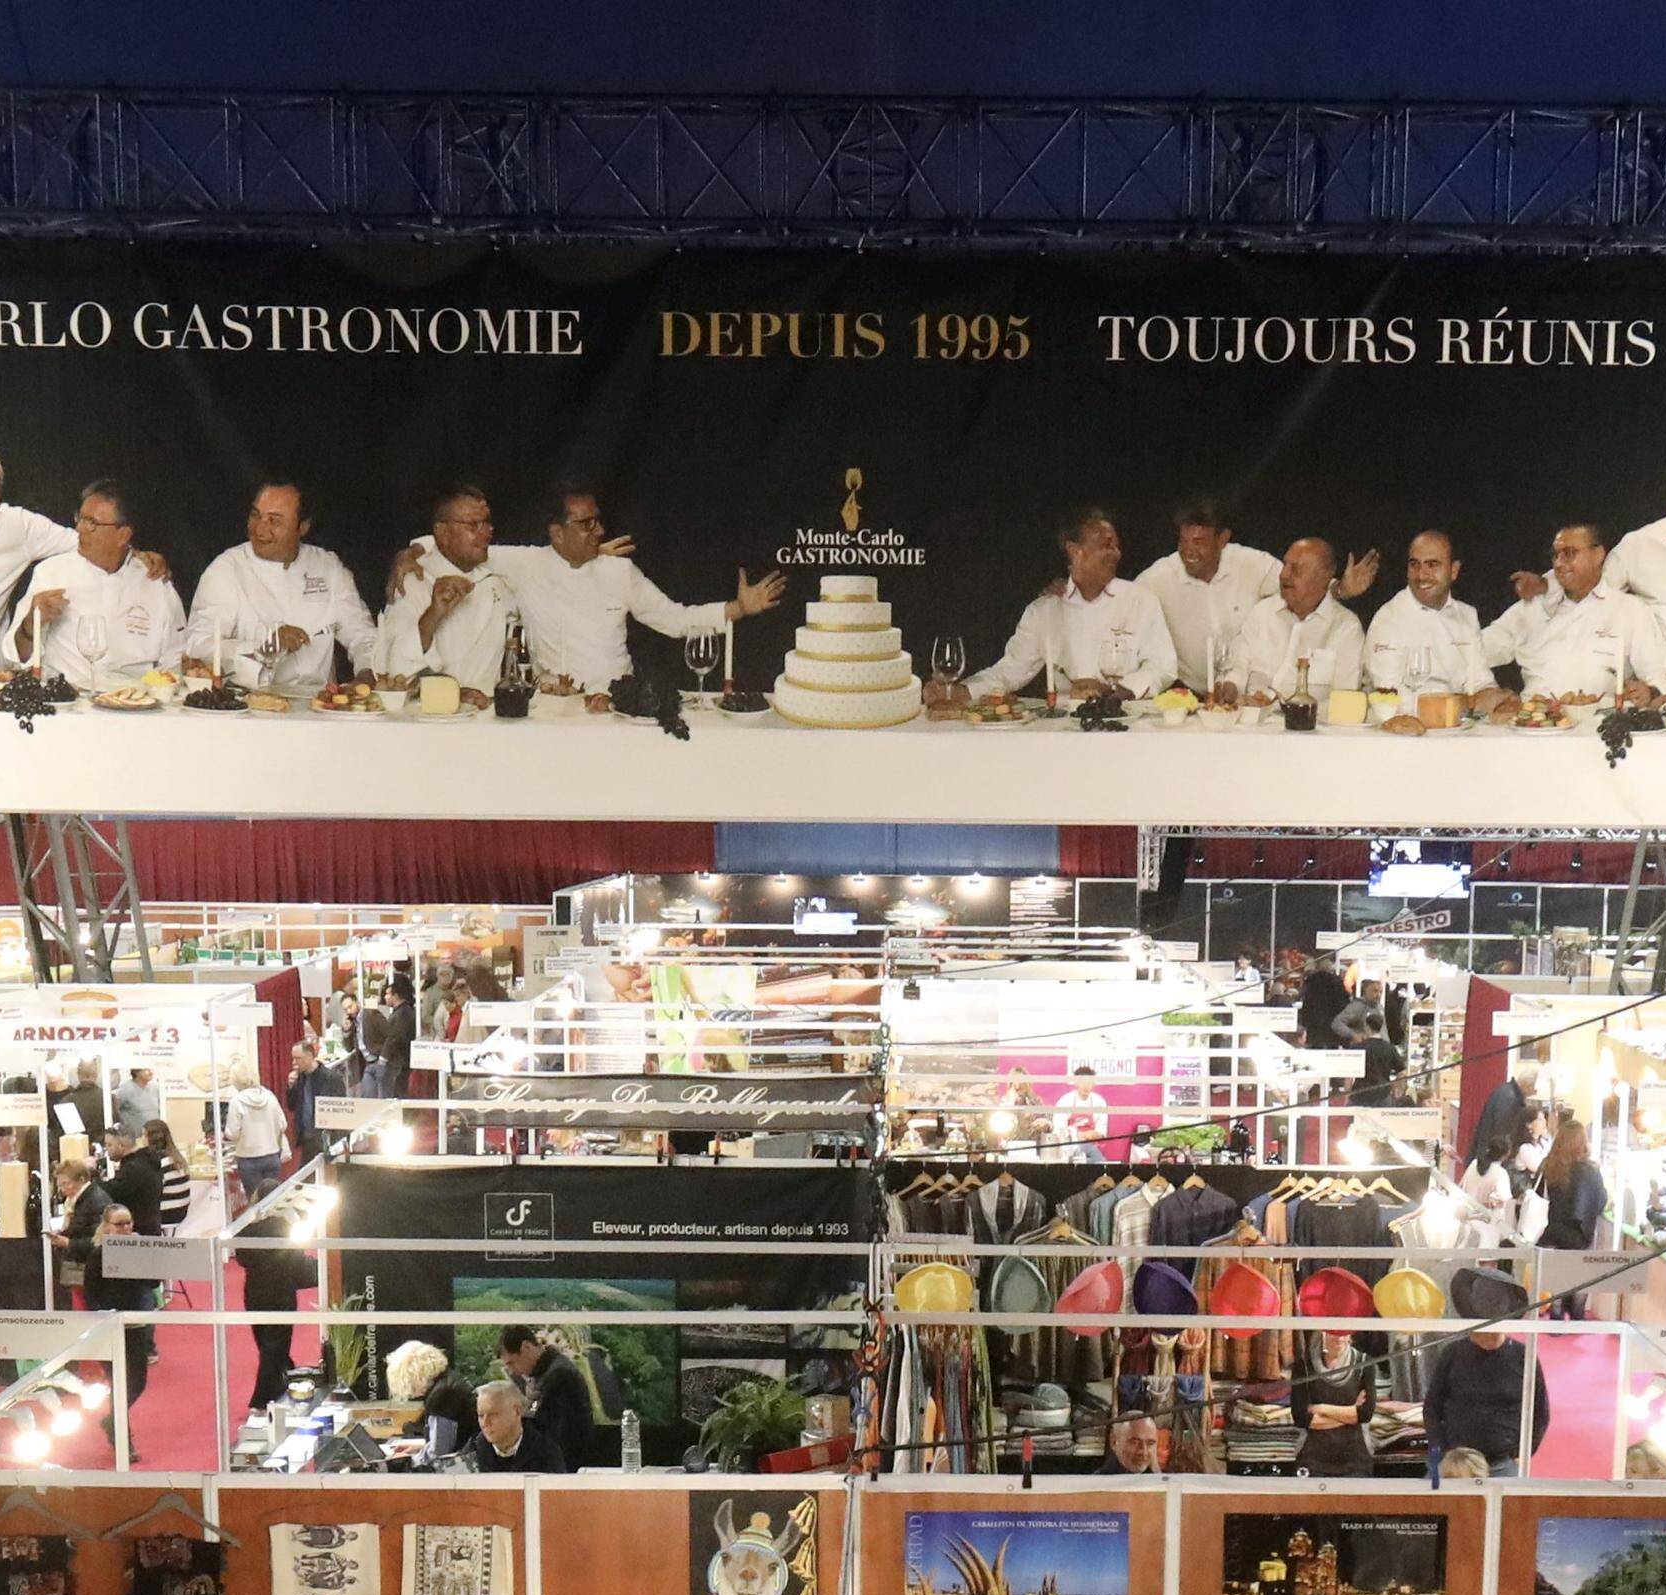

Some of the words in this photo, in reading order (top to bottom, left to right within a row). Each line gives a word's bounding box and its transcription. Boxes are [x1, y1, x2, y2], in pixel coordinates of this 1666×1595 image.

[133, 302, 582, 356] GASTRONOMIE
[660, 311, 885, 358] DEPUIS
[911, 313, 1031, 360] 1995
[1098, 315, 1416, 363] TOUJOURS
[1437, 306, 1656, 367] RÉUNIS
[795, 528, 905, 546] Monte-Carlo
[776, 548, 926, 566] GASTRONOMIE
[592, 1221, 645, 1237] Eleveur,
[648, 1222, 721, 1238] producteur,
[724, 1222, 767, 1235] artisan
[771, 1223, 813, 1238] depuis
[817, 1223, 849, 1236] 1993
[107, 1238, 137, 1247] CAVIAR
[153, 1241, 186, 1249] FRANCE
[365, 1275, 377, 1401] w.caviardefrae.com
